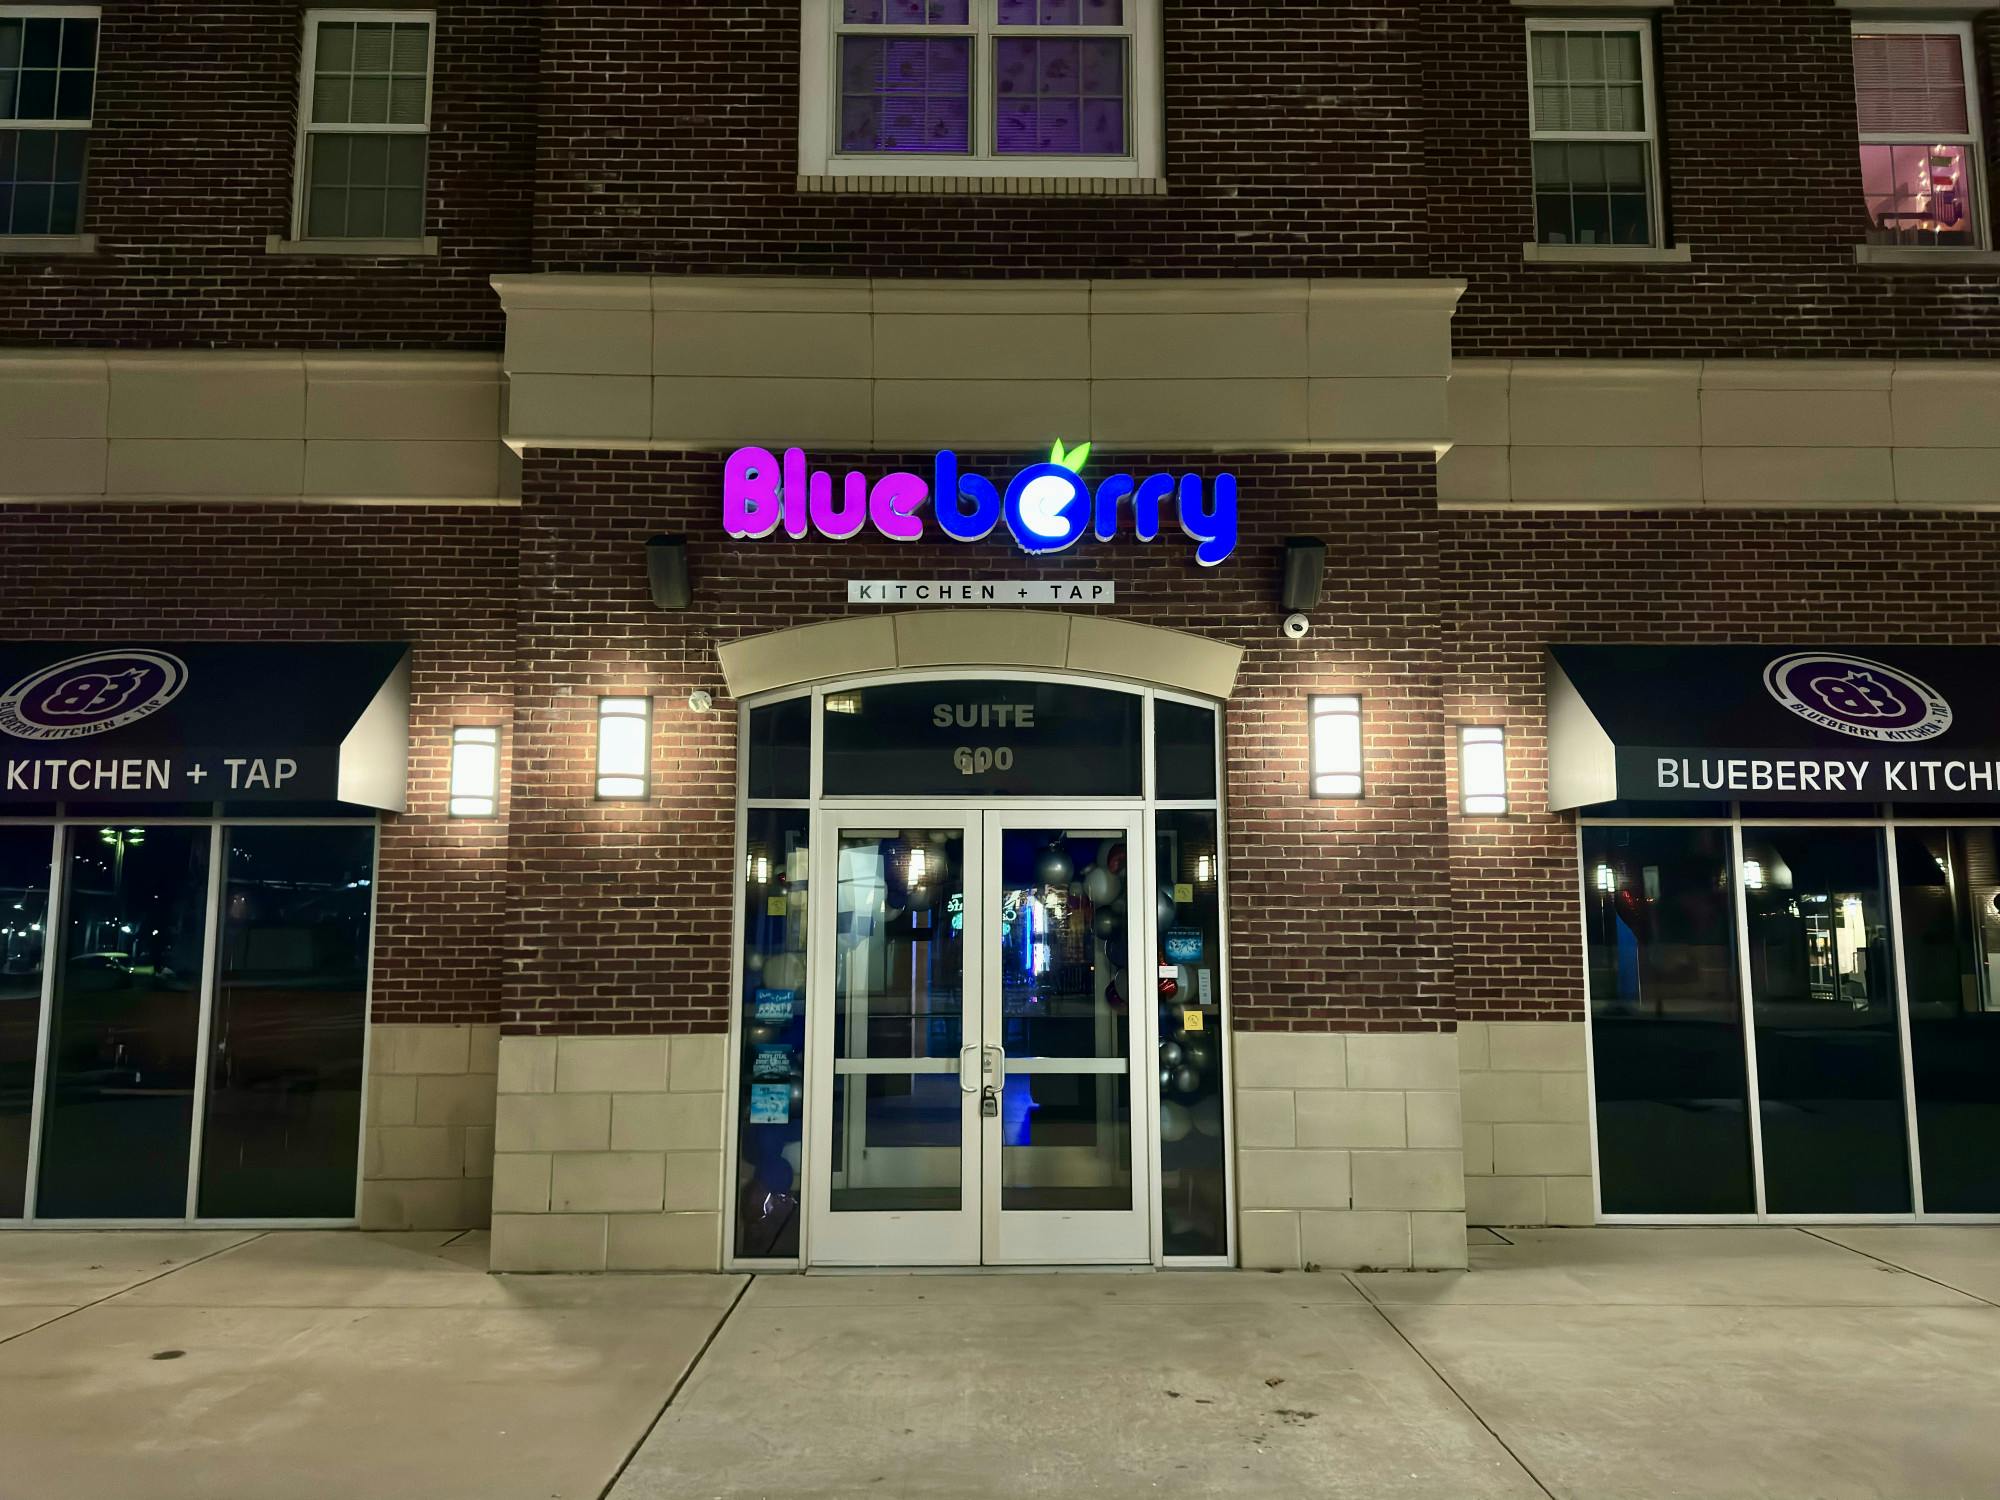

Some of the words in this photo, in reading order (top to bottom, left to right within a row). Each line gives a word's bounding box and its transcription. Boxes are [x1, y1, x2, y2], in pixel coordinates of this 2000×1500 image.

[722, 446, 1238, 567] Blueberry
[860, 584, 995, 600] KITCHEN
[1050, 584, 1103, 600] TAP
[40, 720, 116, 738] KITCHEN
[135, 699, 162, 715] TAP
[932, 703, 1035, 728] SUITE
[1790, 702, 1880, 739] BLUEBERRY
[1885, 721, 1941, 741] KITCHEN
[1930, 702, 1948, 718] TAP
[6, 758, 171, 791] KITCHEN
[186, 762, 208, 784] +
[223, 758, 299, 789] TAP
[953, 746, 1014, 771] 600
[1657, 757, 1870, 791] BLUEBERRY
